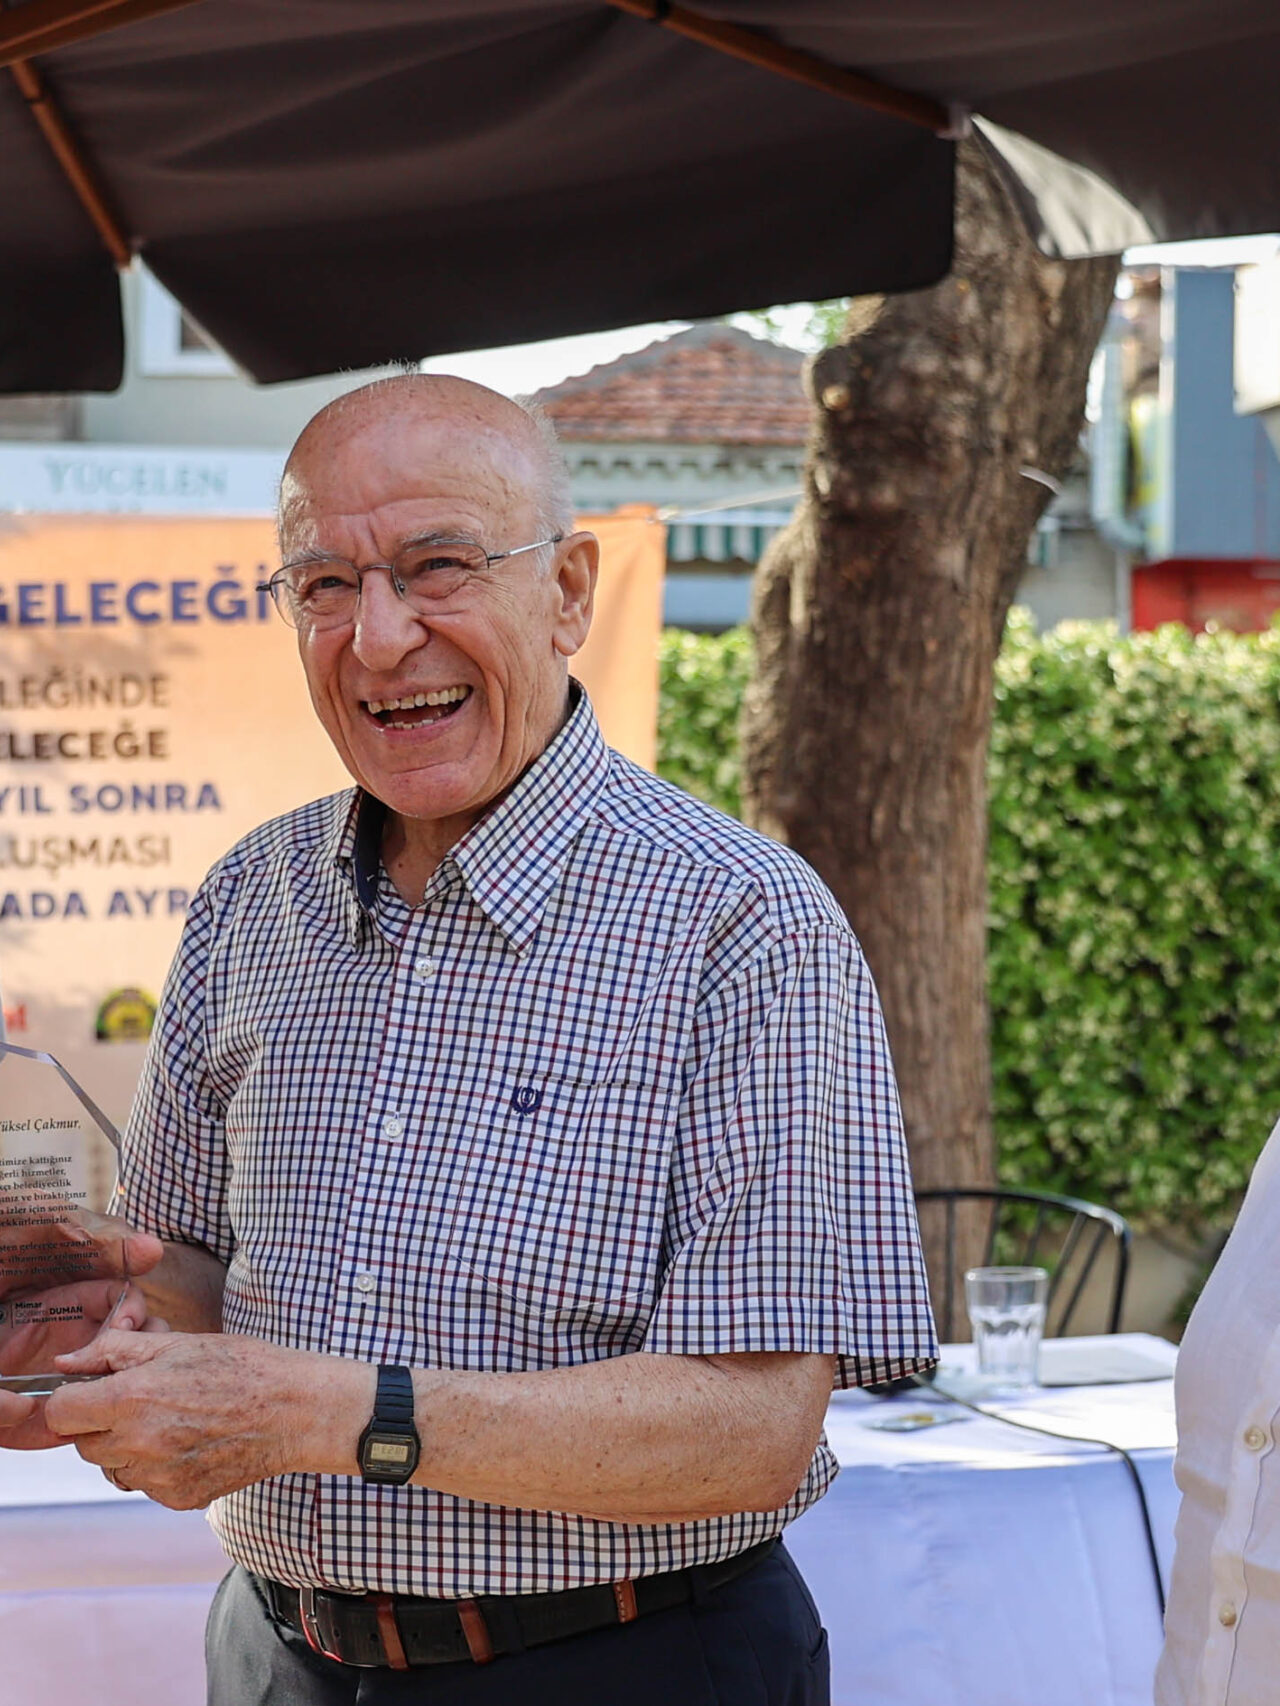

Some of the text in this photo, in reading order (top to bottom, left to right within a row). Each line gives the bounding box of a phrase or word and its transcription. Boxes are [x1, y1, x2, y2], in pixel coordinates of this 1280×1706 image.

[70, 783, 222, 813] SONRA
[34, 1118, 81, 1133] Çakmur,
[29, 1155, 72, 1166] kattığınız
[21, 1167, 67, 1178] hizmetler,
[13, 1179, 72, 1190] belediyecilik
[34, 1191, 87, 1202] bıraktığınız
[6, 1205, 27, 1215] izler
[29, 1204, 46, 1215] için
[48, 1204, 79, 1213] sonsuz
[15, 1301, 42, 1310] Mimar
[49, 1306, 83, 1315] DUMAN
